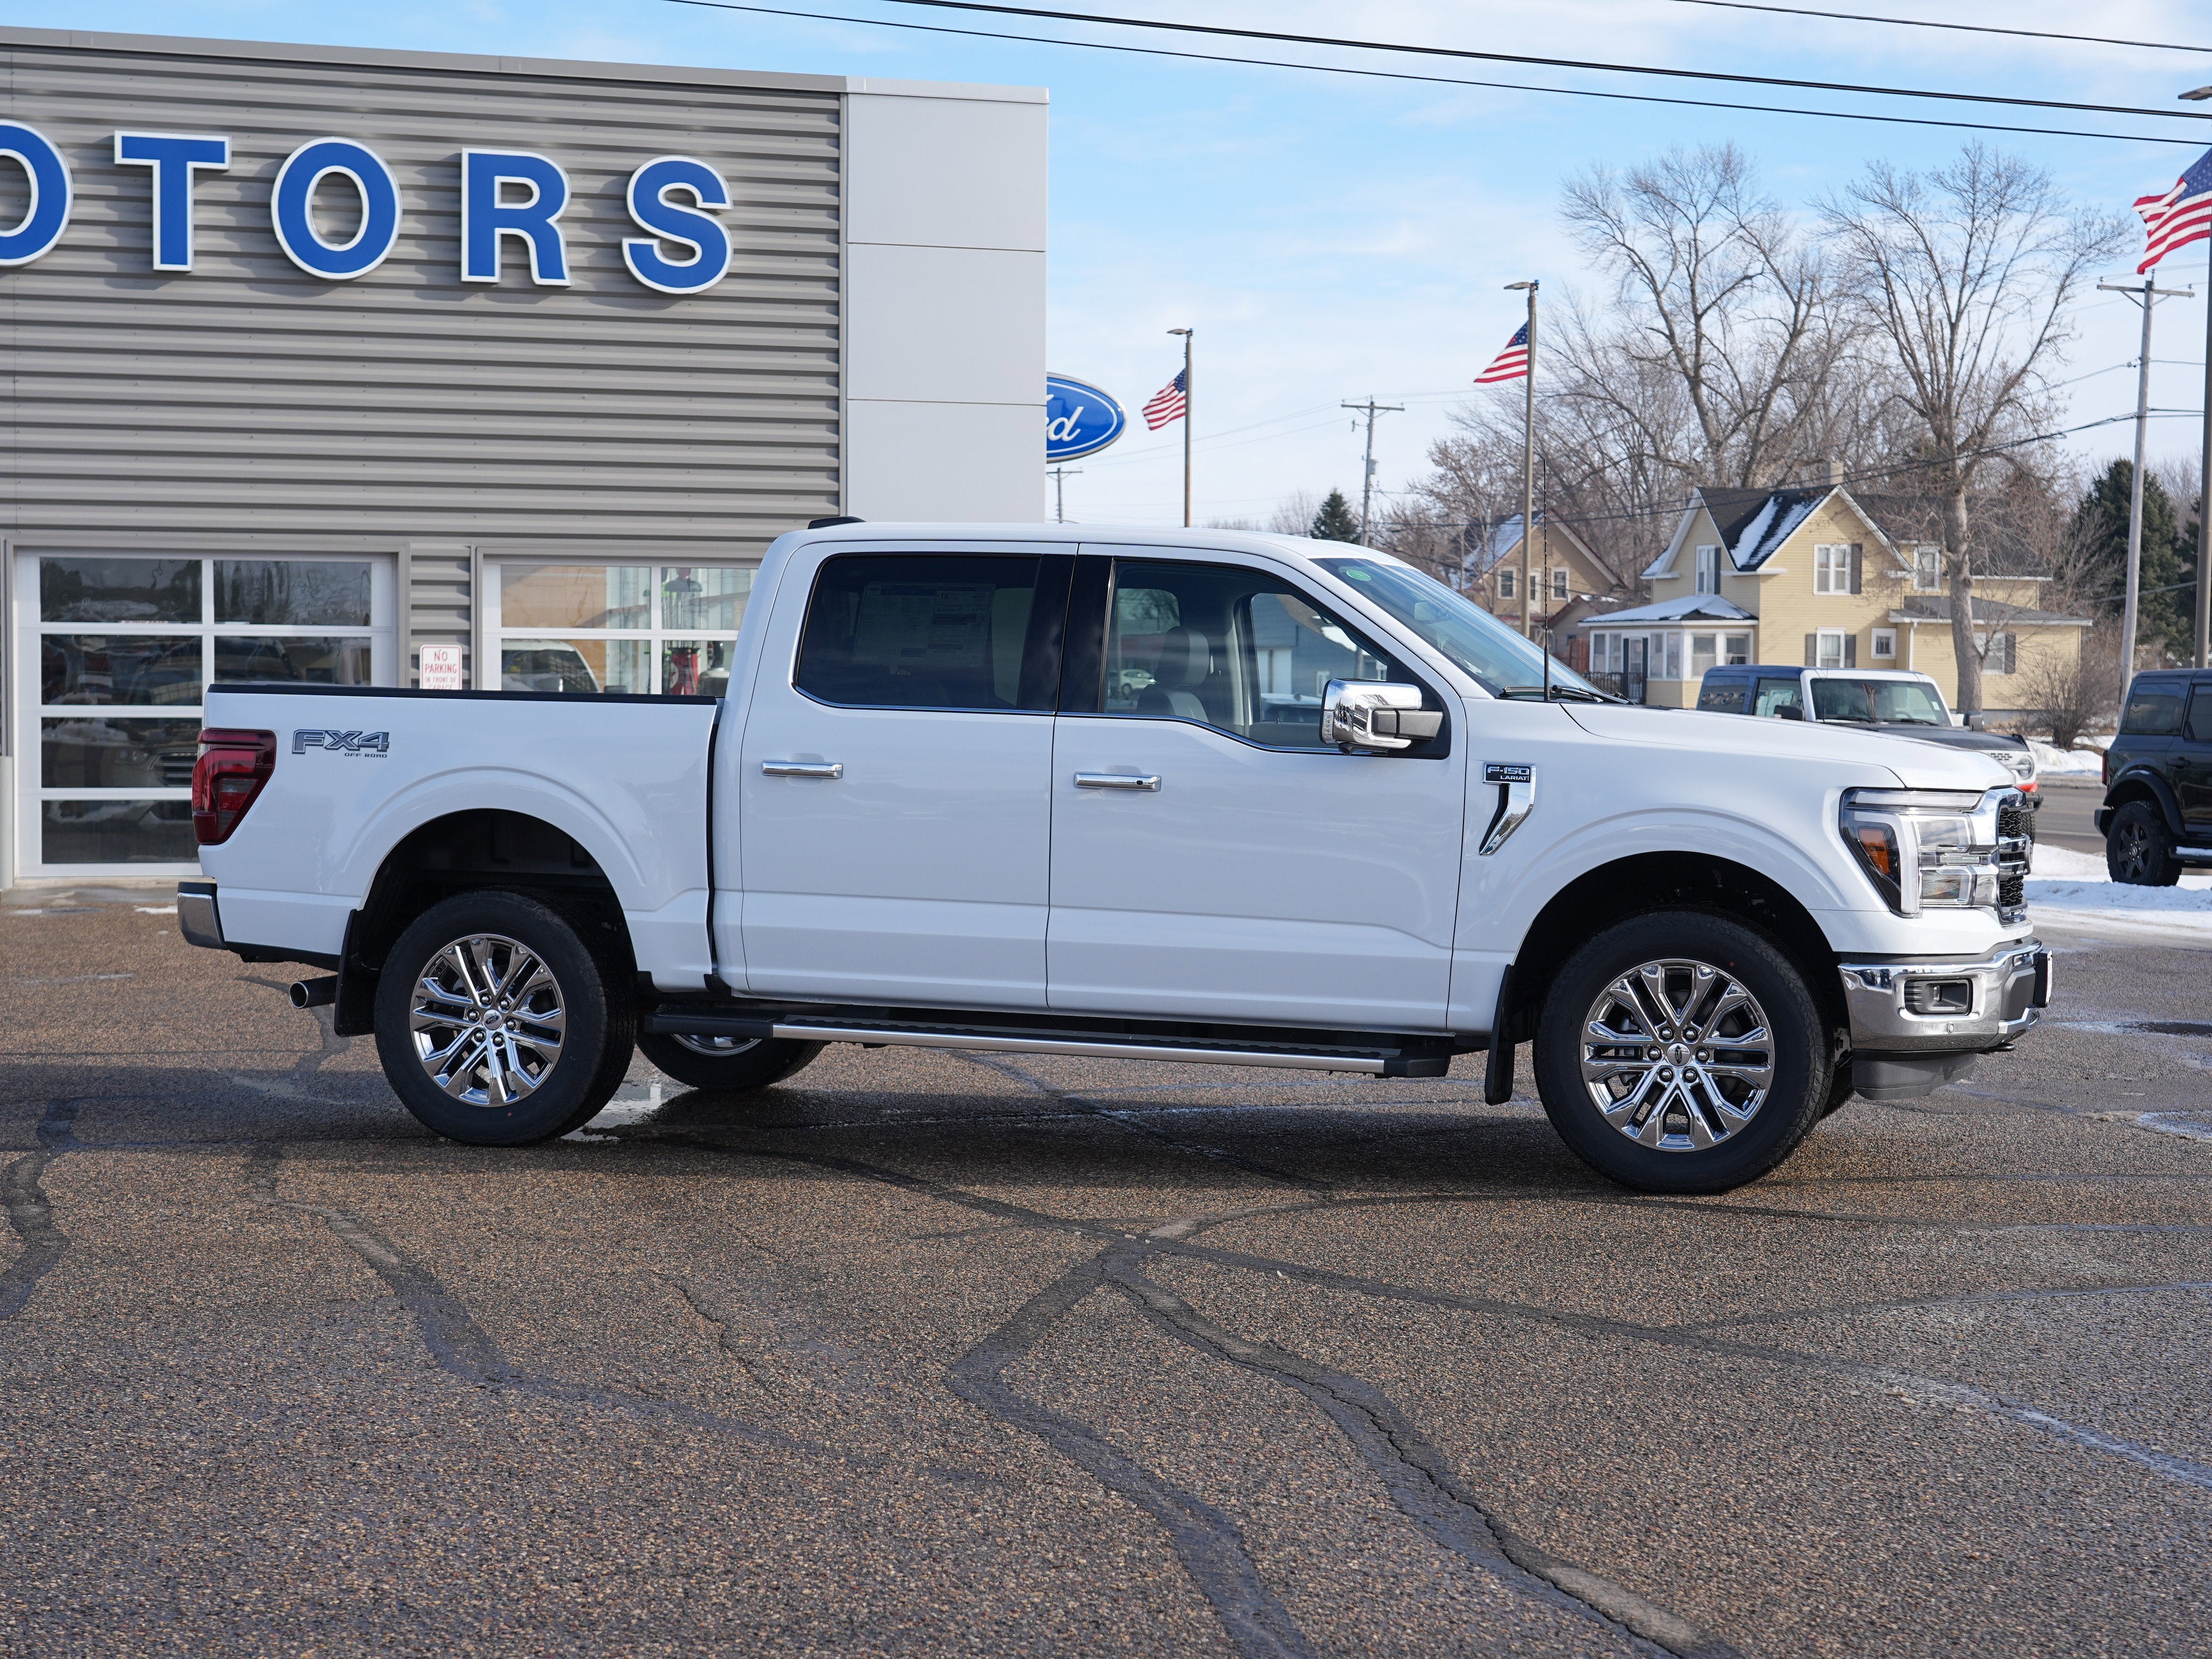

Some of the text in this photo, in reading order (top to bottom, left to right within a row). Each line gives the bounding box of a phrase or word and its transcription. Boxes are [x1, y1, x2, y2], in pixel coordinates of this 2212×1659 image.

[434, 650, 448, 662] NO
[425, 663, 457, 673] PARKING
[292, 729, 389, 754] FX4
[1487, 766, 1530, 775] F-150
